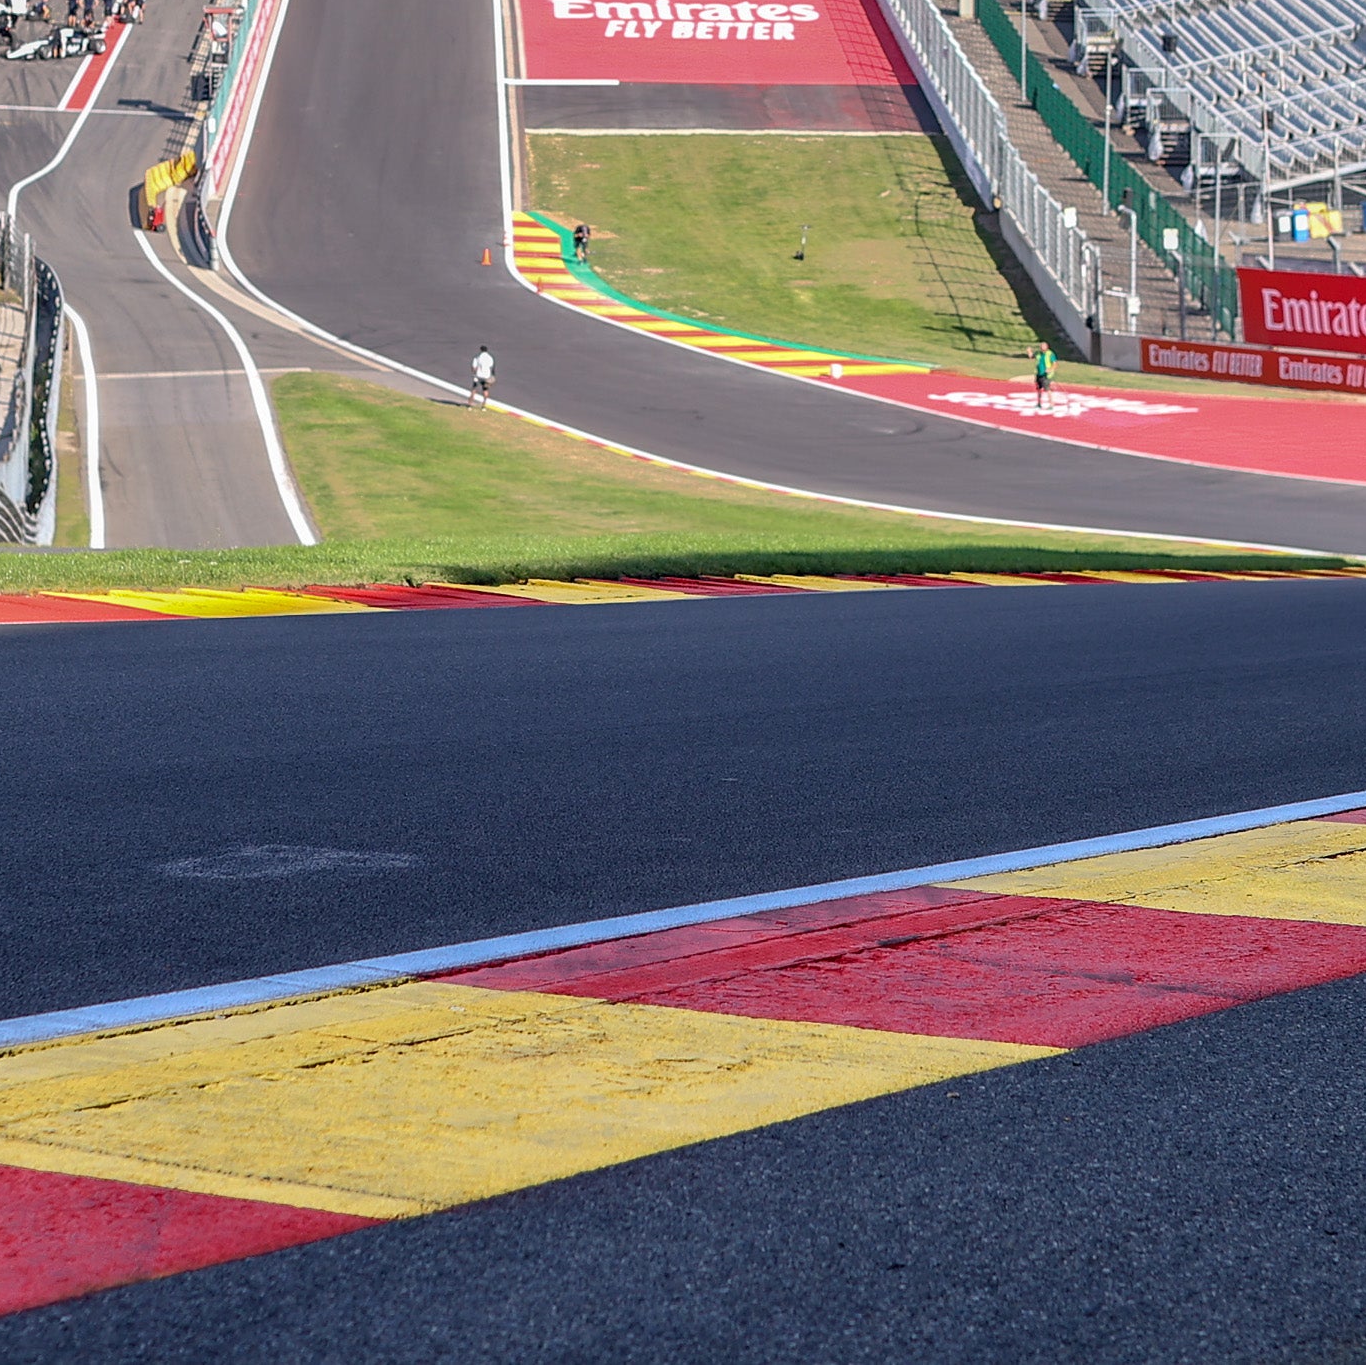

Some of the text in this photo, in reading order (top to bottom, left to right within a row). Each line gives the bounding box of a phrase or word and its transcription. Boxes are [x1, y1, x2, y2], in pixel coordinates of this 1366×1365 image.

[604, 20, 796, 41] FLY BETTER
[1148, 343, 1264, 378] Emirates FLY BETTER
[1278, 356, 1344, 385] Emirates
[1346, 363, 1364, 389] FLY
